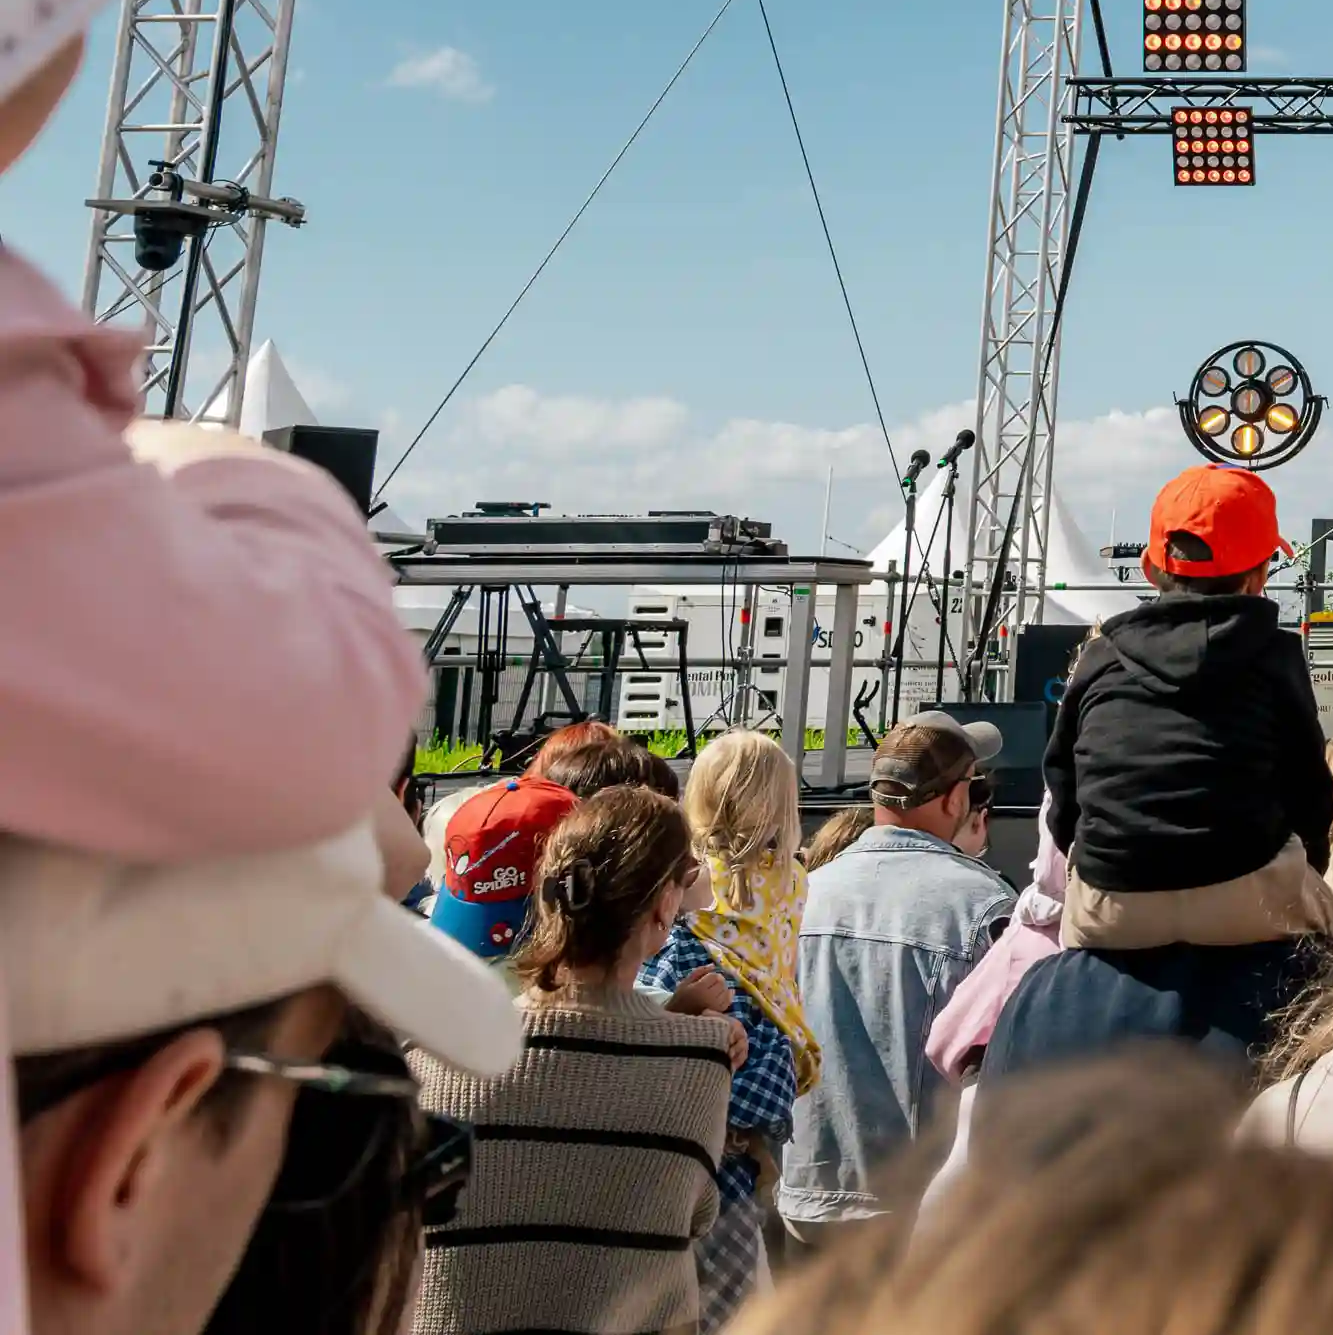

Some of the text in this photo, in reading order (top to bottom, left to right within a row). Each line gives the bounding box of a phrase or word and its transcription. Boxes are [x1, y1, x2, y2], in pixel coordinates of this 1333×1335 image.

[817, 630, 864, 649] SO
[473, 871, 526, 895] SPIDEY!
[493, 866, 518, 881] GO
